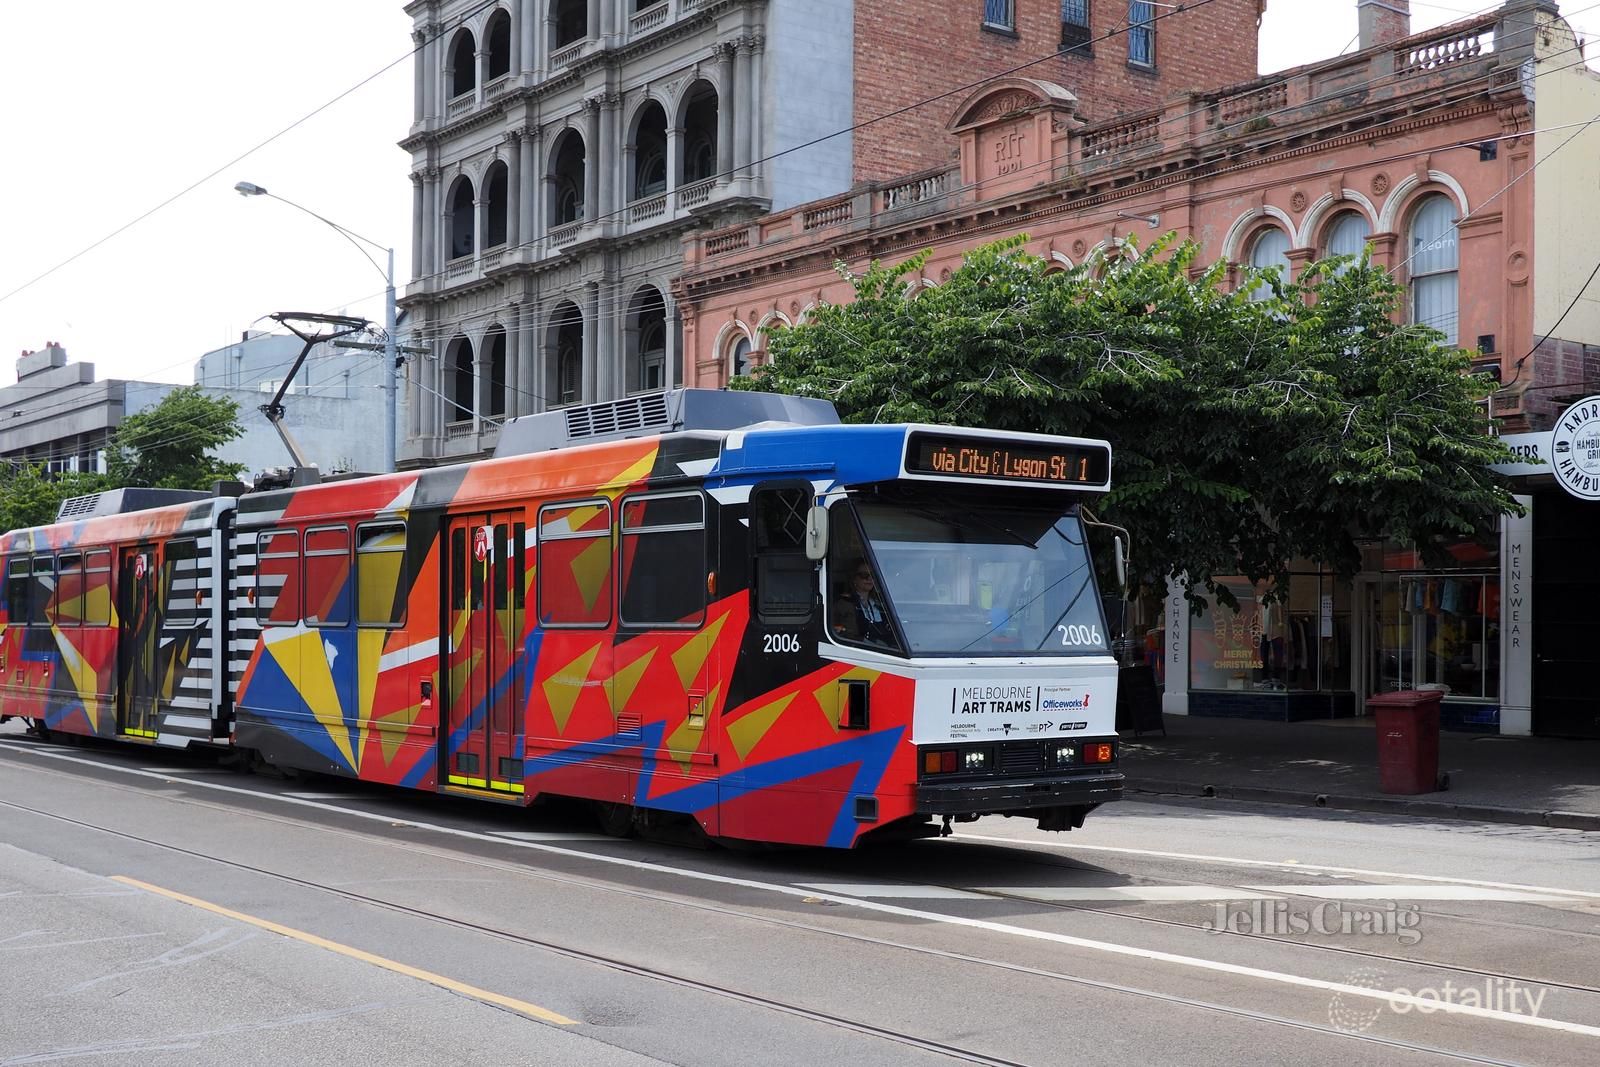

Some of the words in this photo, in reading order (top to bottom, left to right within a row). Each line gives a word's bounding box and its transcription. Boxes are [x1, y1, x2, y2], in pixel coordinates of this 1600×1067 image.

[1564, 404, 1599, 434] ANDR
[933, 447, 955, 472] via
[959, 449, 989, 474] City
[1004, 452, 1047, 478] Lygon
[1050, 456, 1067, 480] St
[1079, 458, 1087, 481] 1
[1559, 458, 1599, 491] HAMBU
[1510, 543, 1522, 648] MENSWEAR
[1057, 624, 1102, 647] 2006
[1172, 597, 1180, 663] CHANCE
[763, 634, 800, 653] 2006
[1223, 650, 1253, 658] MERRY
[1214, 660, 1264, 669] CHRISTMAS
[962, 686, 1032, 699] MELBOURNE
[961, 701, 987, 714] ART
[990, 700, 1031, 713] TRAMS
[1042, 698, 1082, 709] Officeworks
